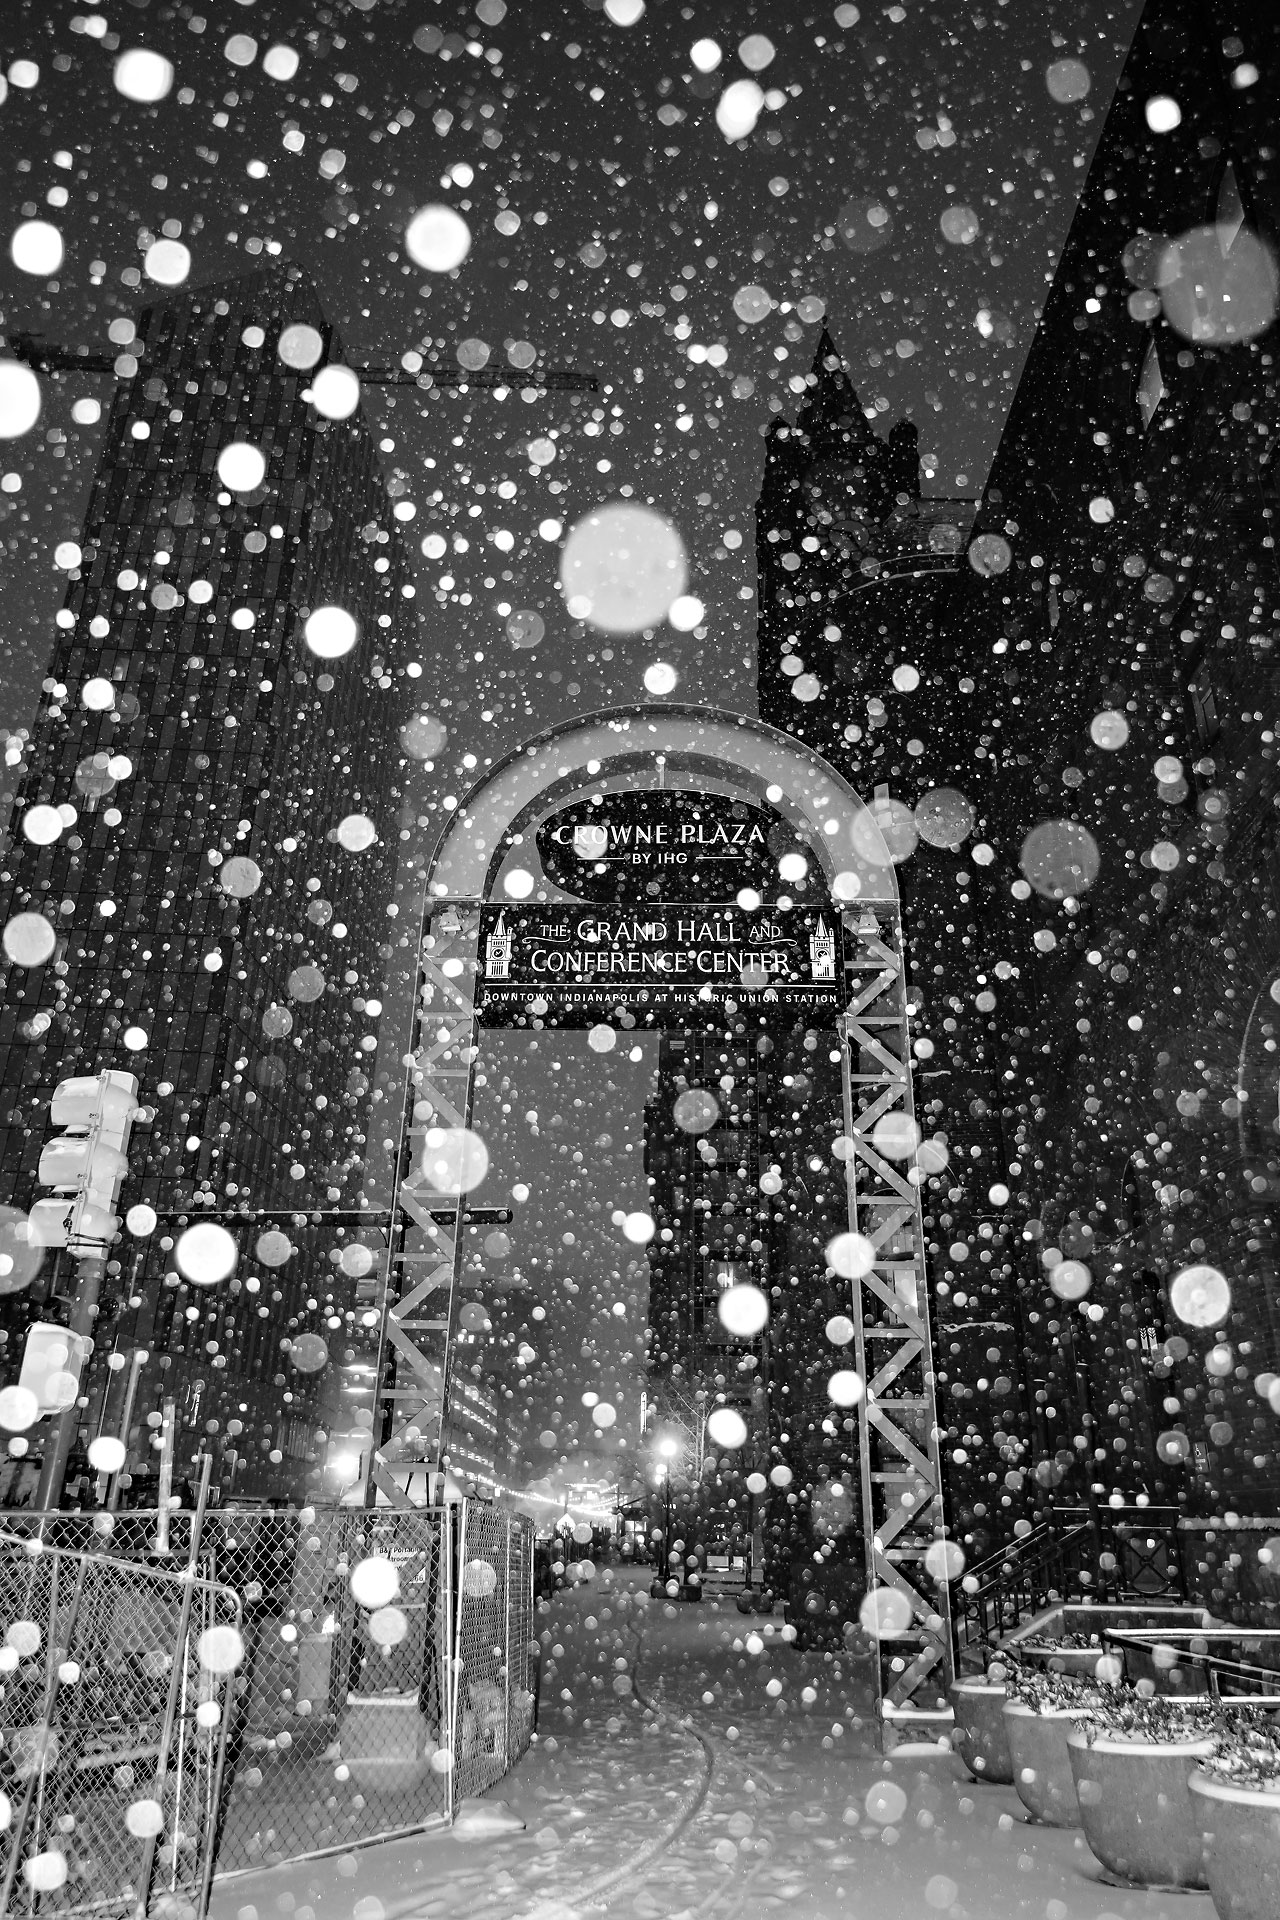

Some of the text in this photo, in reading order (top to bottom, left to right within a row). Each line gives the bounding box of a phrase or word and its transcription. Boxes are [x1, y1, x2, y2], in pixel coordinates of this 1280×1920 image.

[556, 824, 765, 845] CROWNE PLAZA
[632, 853, 688, 864] BY IHG
[540, 919, 781, 942] THE GRAND HALL AND
[530, 950, 791, 973] CONFERENCE CENTER
[484, 992, 553, 1001] DOWNTOWN
[560, 993, 649, 1002] INDIANAPOLIS
[654, 993, 668, 1002] AT
[739, 994, 779, 1003] UNION
[785, 994, 837, 1003] STATION
